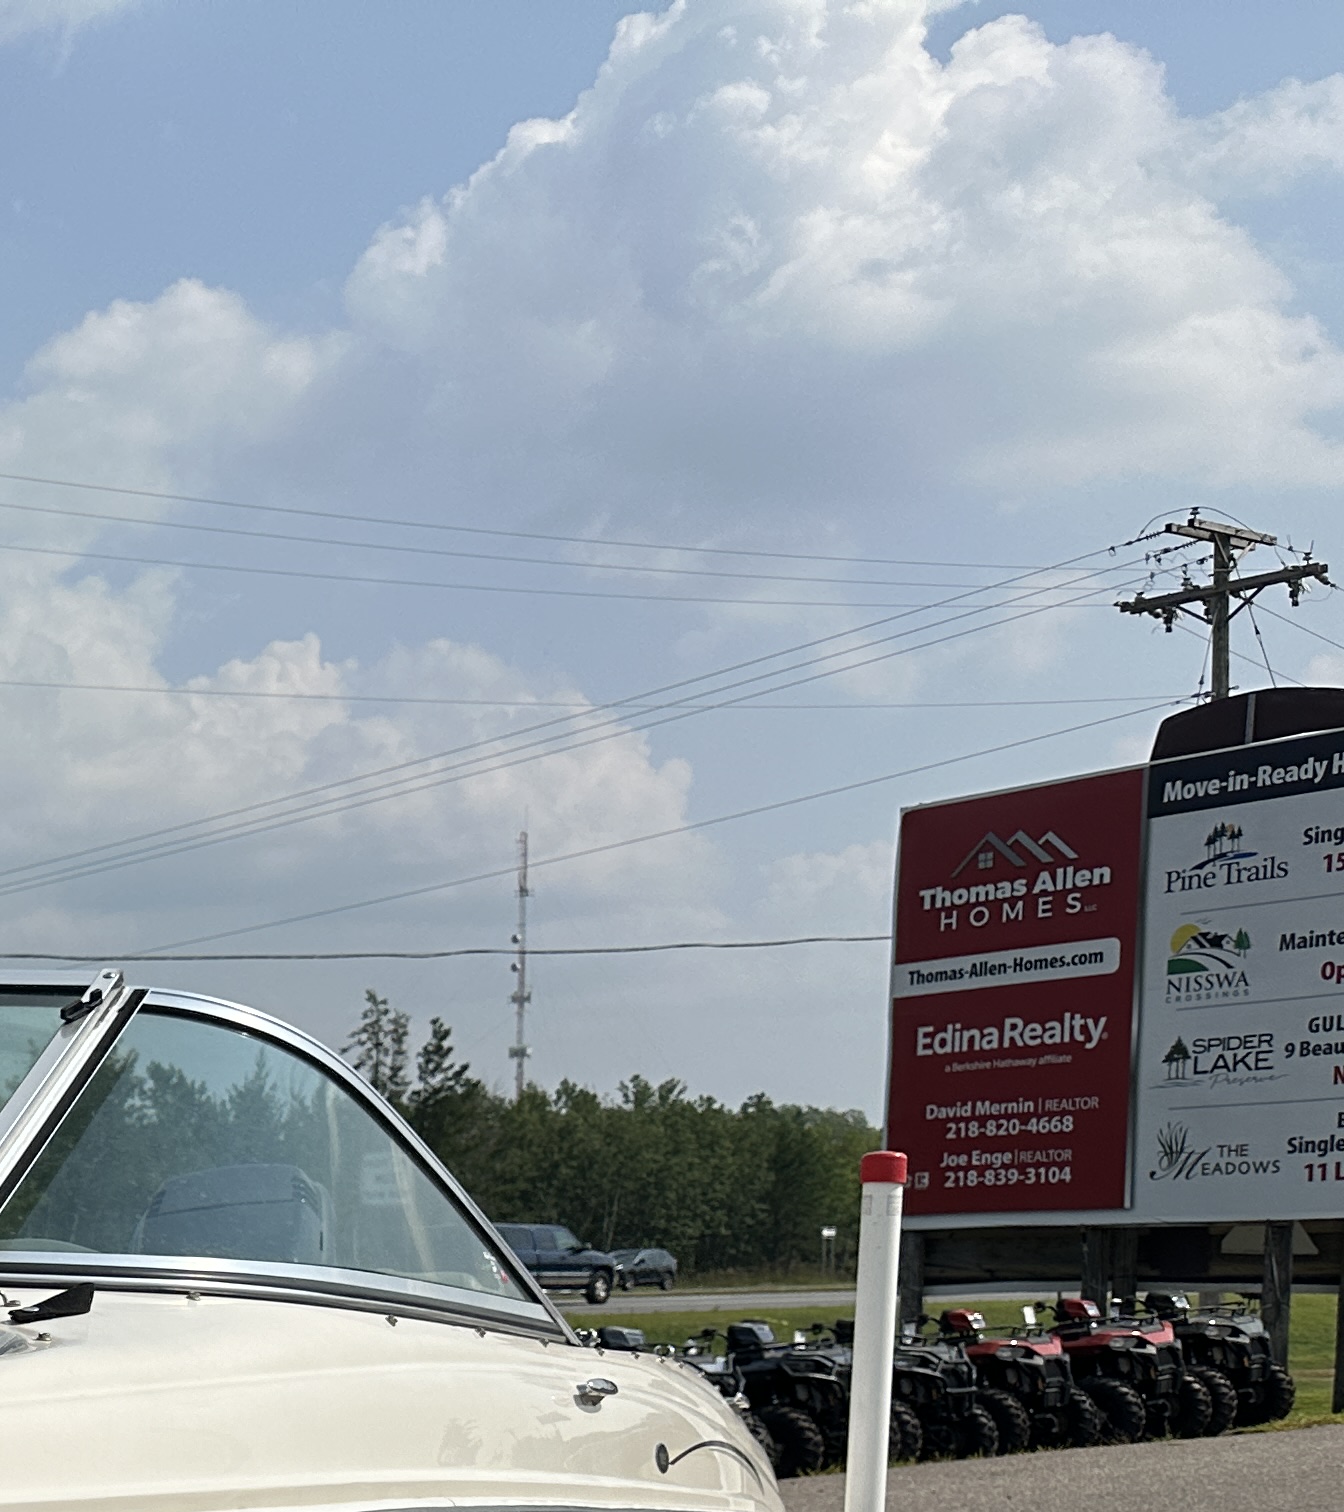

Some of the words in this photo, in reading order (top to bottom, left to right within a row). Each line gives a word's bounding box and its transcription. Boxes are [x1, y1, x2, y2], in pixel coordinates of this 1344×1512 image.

[1162, 756, 1330, 803] Move-in-Ready
[1164, 868, 1217, 894] Pine
[1219, 856, 1289, 886] Trails
[918, 878, 1028, 911] Thomas
[1032, 865, 1112, 895] Allen
[939, 892, 1082, 933] HOMES
[1278, 929, 1344, 952] Mainte
[908, 950, 1104, 986] Thomas-Allen-Homes.com
[1166, 970, 1250, 996] NISSWA
[1164, 988, 1251, 1005] CROSSINGS
[916, 1023, 1000, 1056] Edina
[1002, 1012, 1108, 1050] Realty
[1192, 1033, 1274, 1055] SPIDER
[1192, 1049, 1274, 1076] LAKE
[1284, 1042, 1296, 1060] 9
[925, 1100, 972, 1121] David
[974, 1097, 1035, 1117] Mernin
[1044, 1096, 1100, 1113] REALTOR
[945, 1114, 1074, 1140] 218-820-4668
[939, 1152, 968, 1168] Joe
[970, 1149, 1013, 1166] Enge
[1018, 1148, 1073, 1164] REALTOR
[1216, 1143, 1249, 1158] THE
[943, 1166, 1073, 1188] 218-839-3104
[1303, 1161, 1328, 1183] 11
